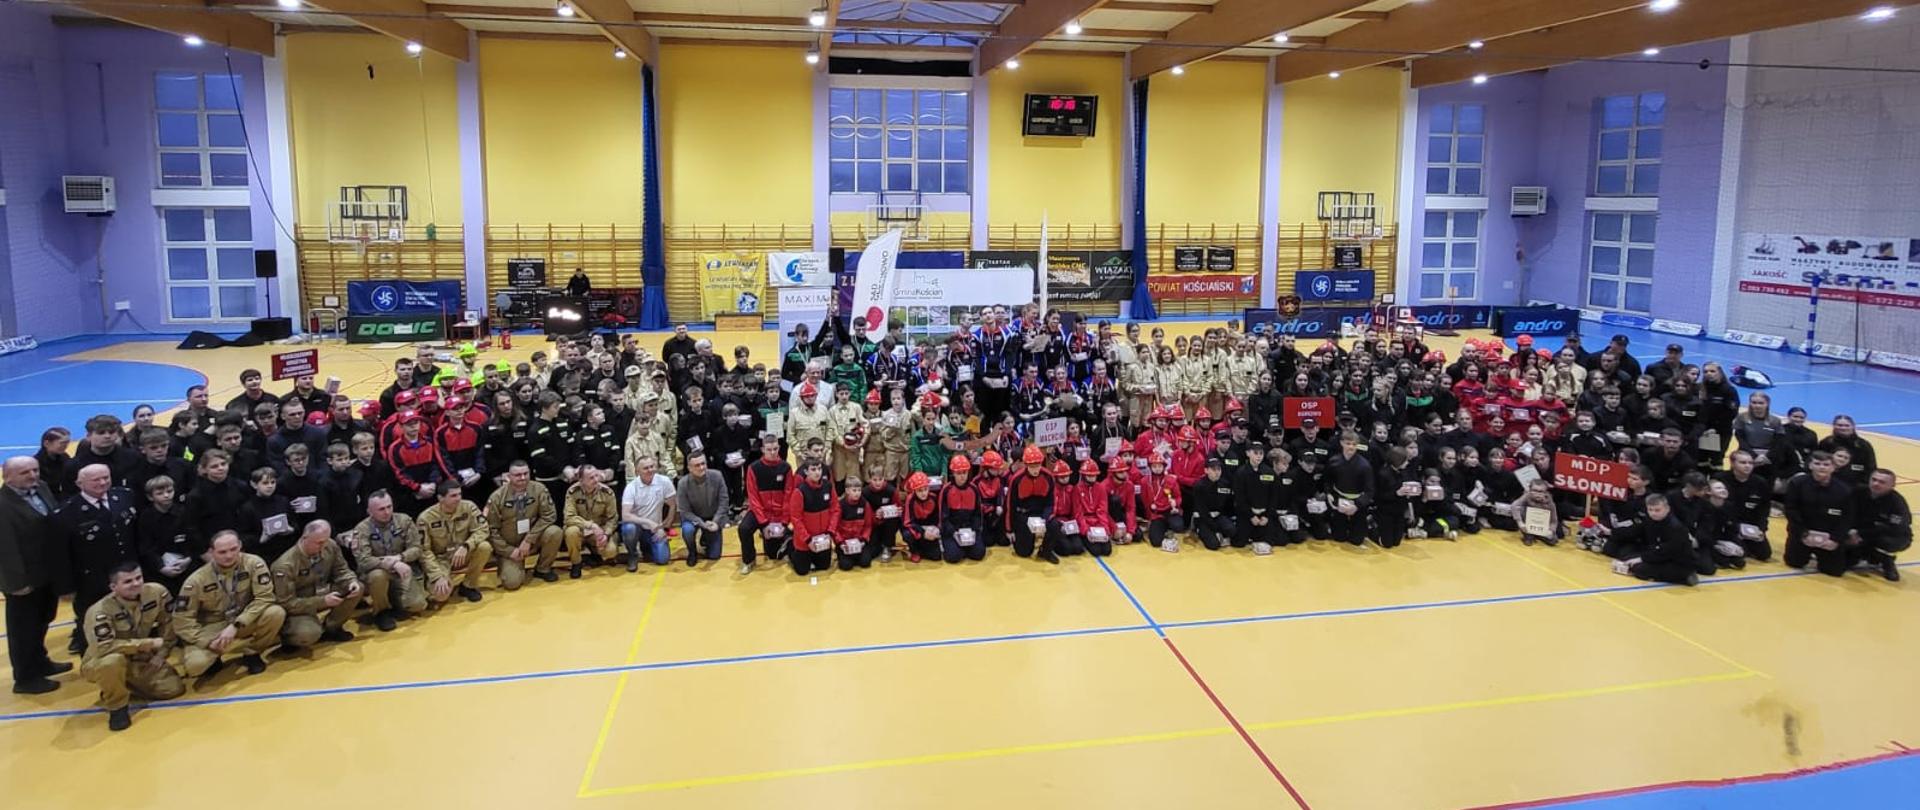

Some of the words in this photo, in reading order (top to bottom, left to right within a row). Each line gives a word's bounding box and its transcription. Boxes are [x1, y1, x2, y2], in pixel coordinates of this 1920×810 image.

[1752, 269, 1789, 279] JAKOŚĆ
[1148, 282, 1180, 293] POWIAT
[1183, 279, 1234, 293] KOŚCIAŃSKI
[358, 321, 437, 336] DOIC
[1514, 319, 1563, 331] andro
[1301, 401, 1318, 410] OSP
[1571, 459, 1611, 476] MDP
[1554, 473, 1627, 499] SŁONIN
